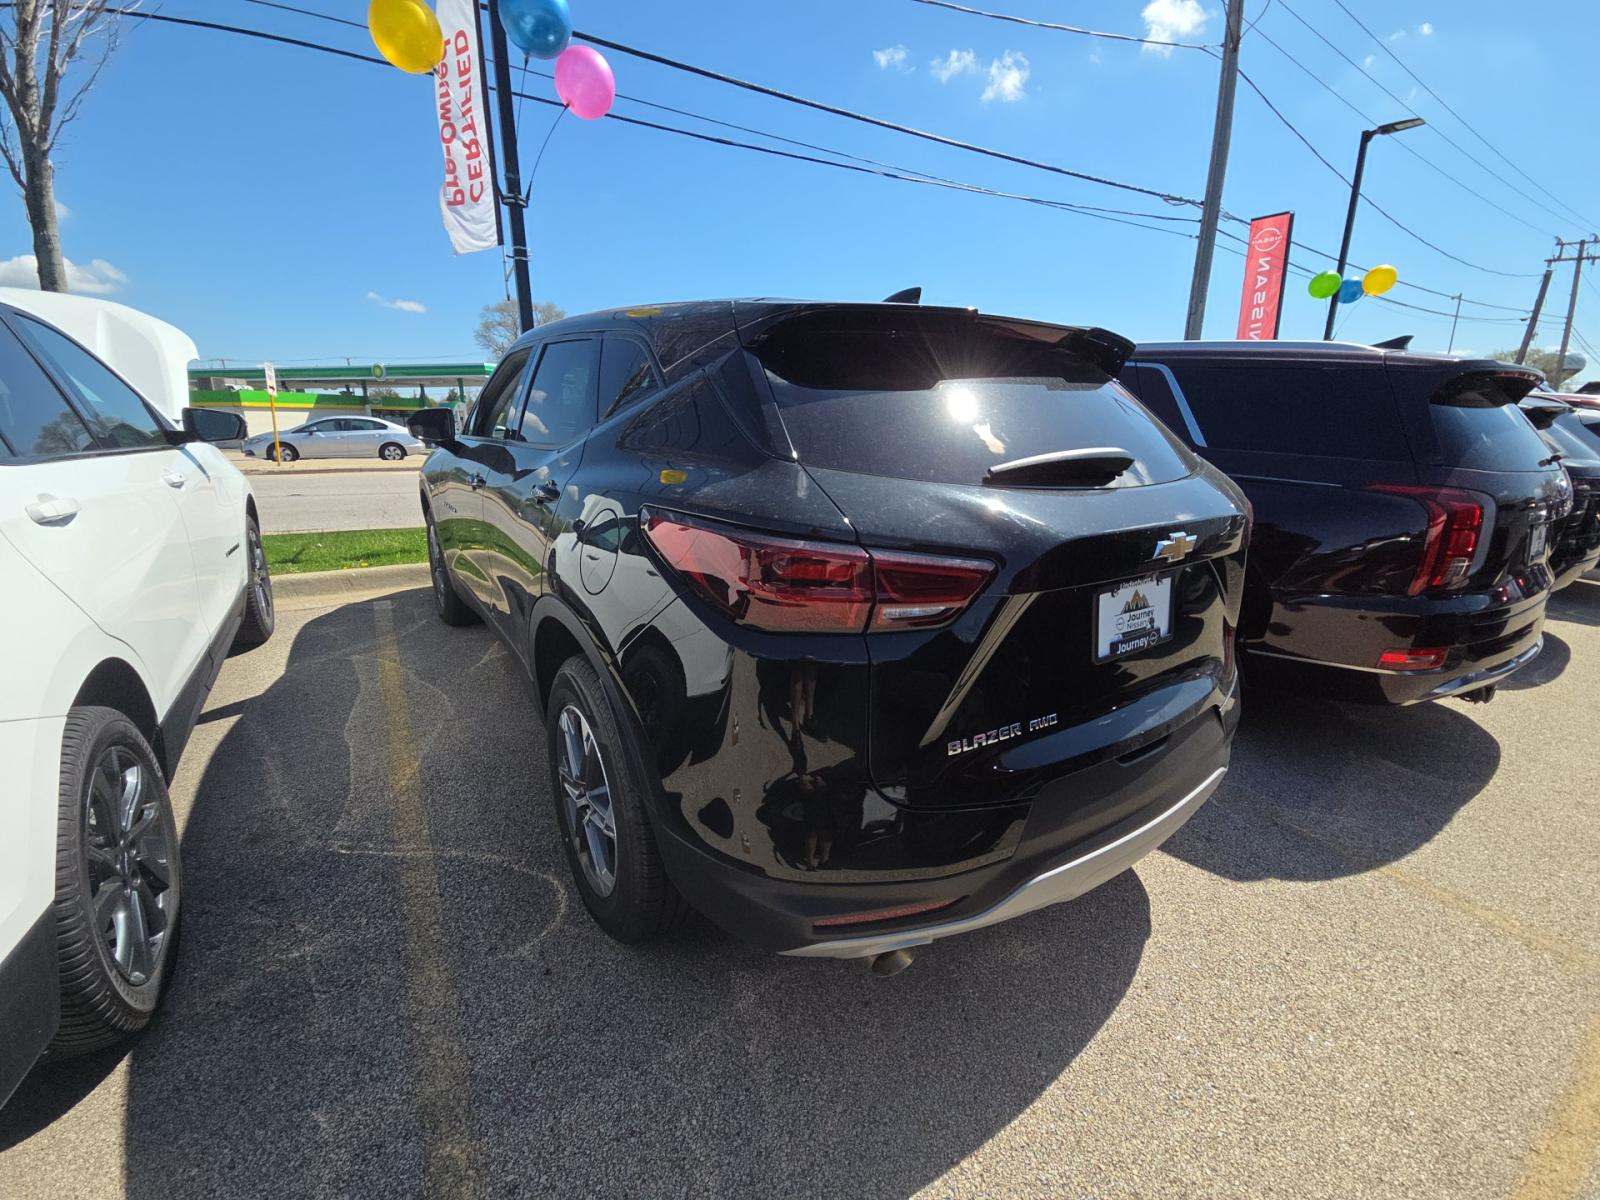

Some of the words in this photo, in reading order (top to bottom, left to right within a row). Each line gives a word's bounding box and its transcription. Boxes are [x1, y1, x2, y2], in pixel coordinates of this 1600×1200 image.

[1127, 609, 1154, 622] Journey
[1117, 636, 1149, 654] Journey
[947, 723, 1022, 756] BLAZER
[1029, 713, 1058, 731] AWD
